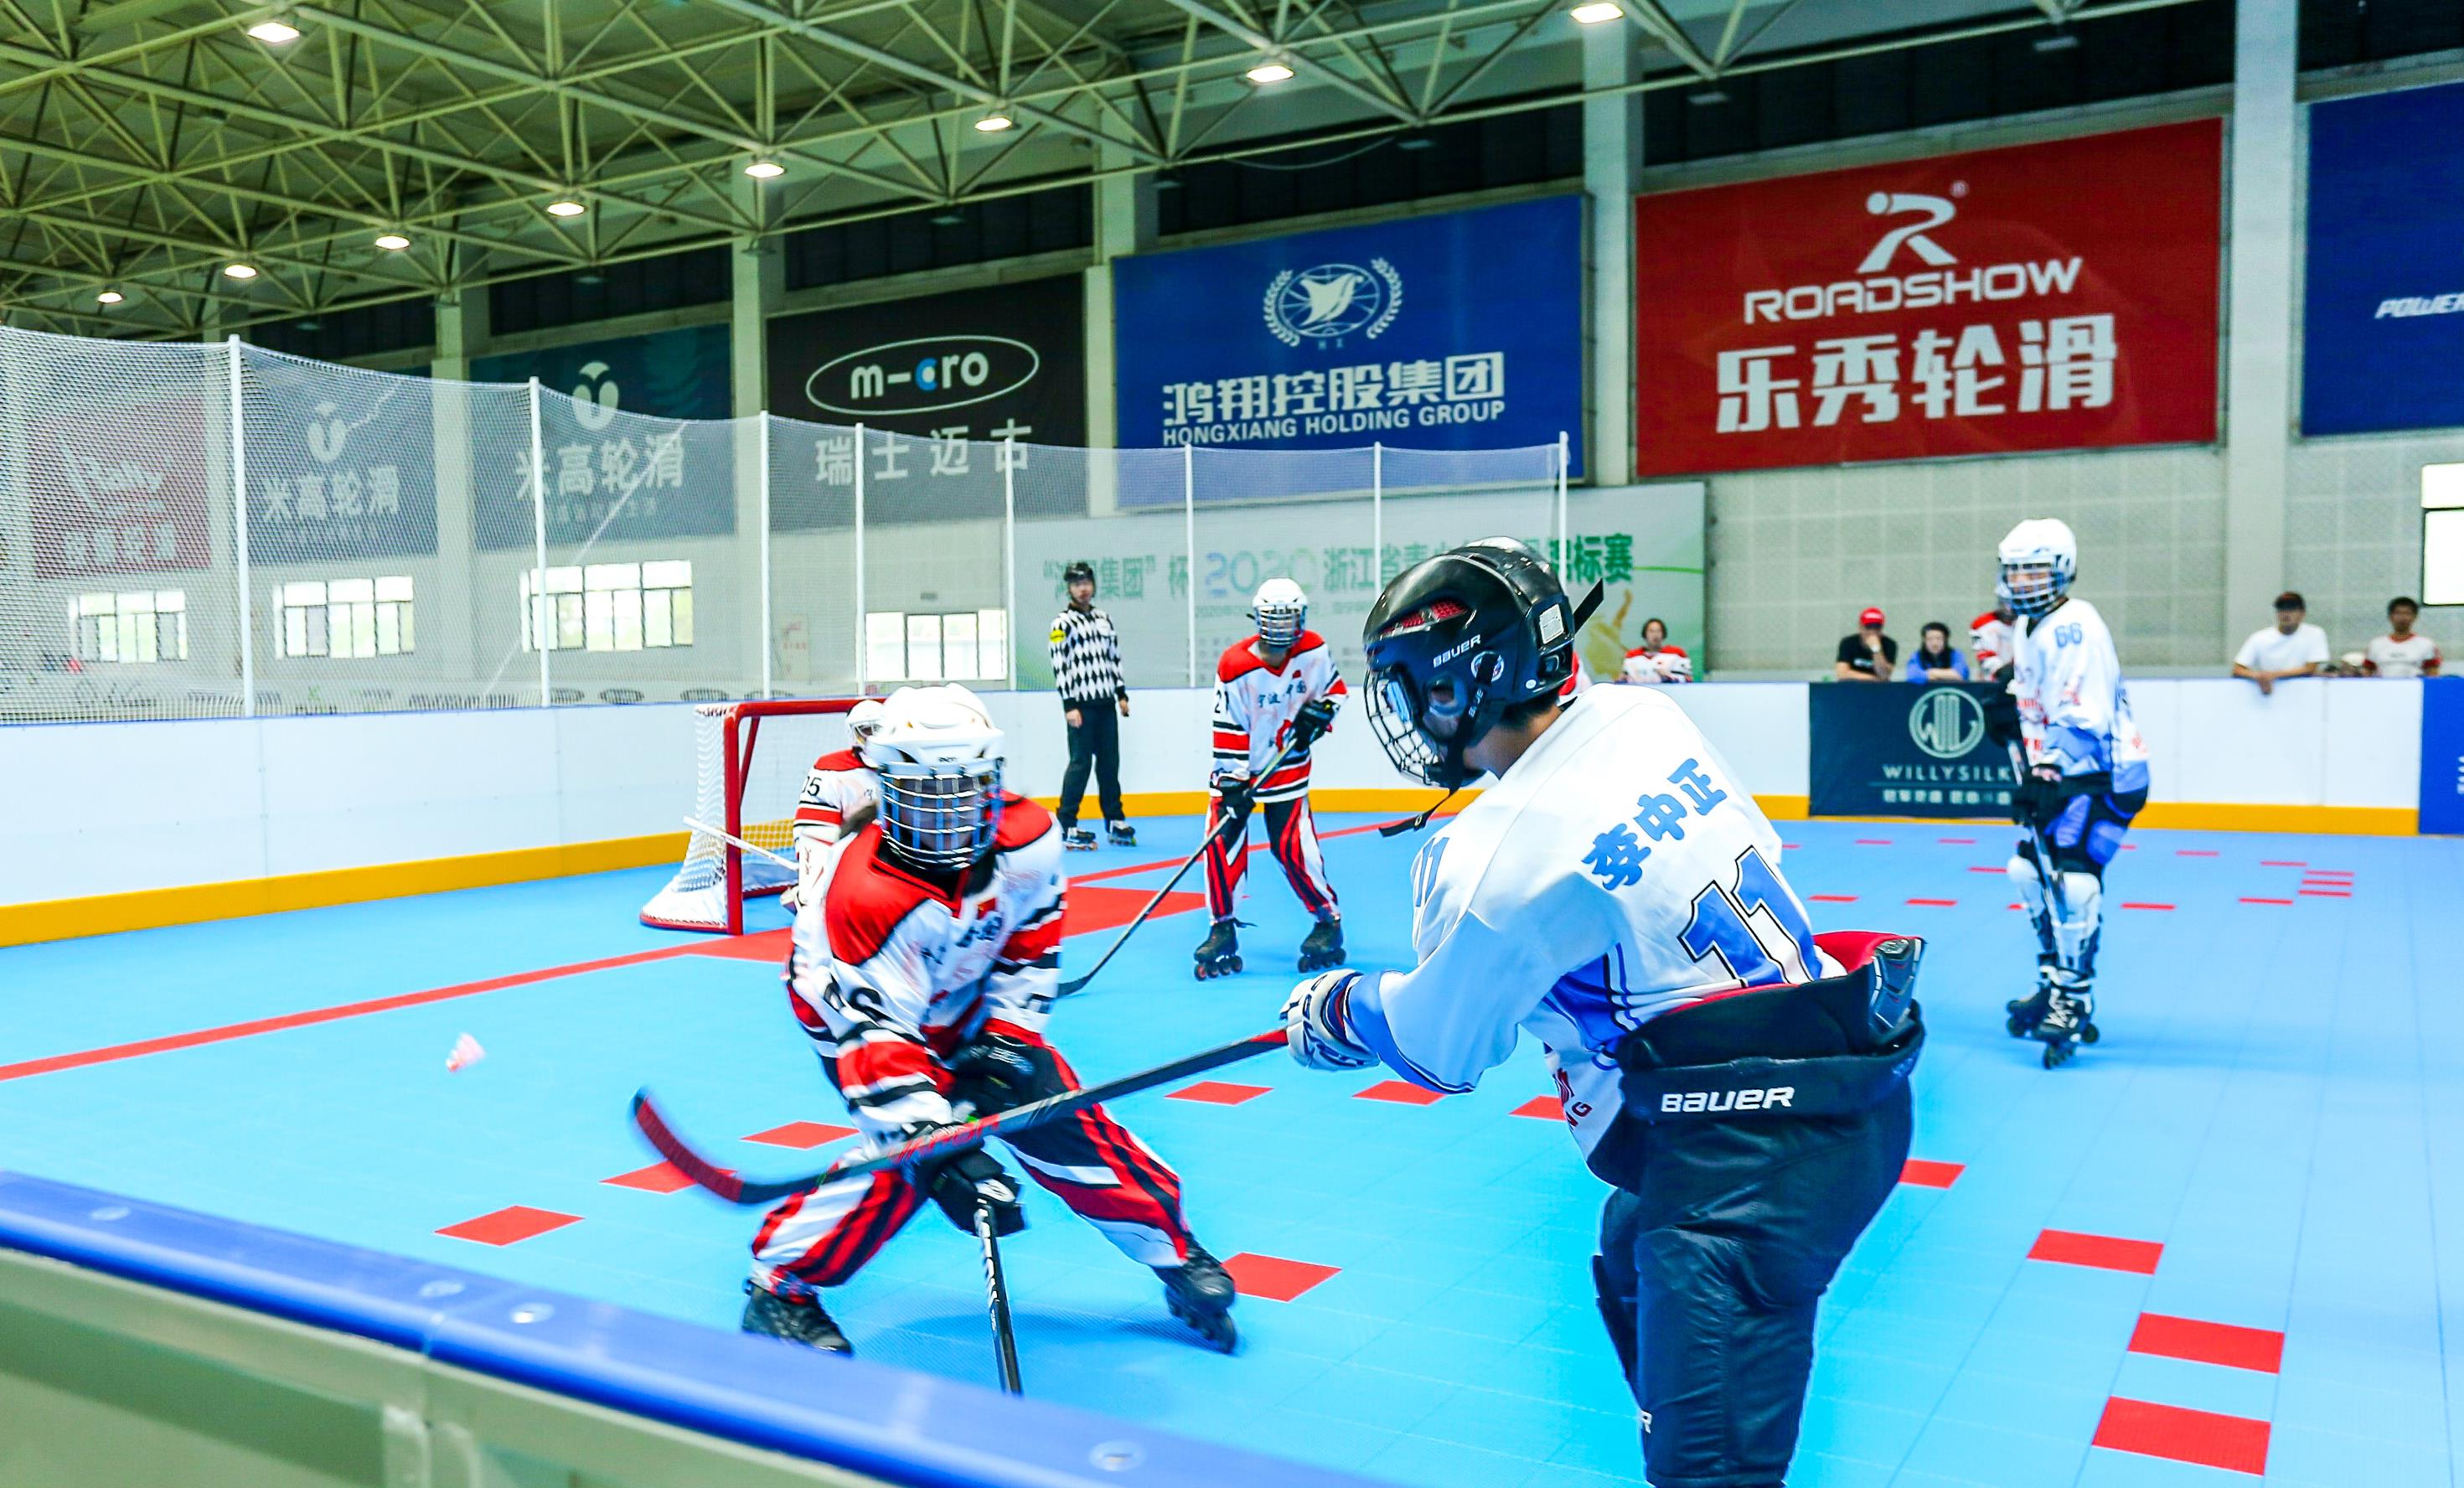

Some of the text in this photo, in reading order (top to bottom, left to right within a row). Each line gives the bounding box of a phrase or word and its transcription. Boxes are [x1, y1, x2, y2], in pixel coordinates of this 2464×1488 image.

[1743, 256, 2084, 325] ROADSHOW
[1162, 351, 1506, 427] 鸿翔控股集团
[1716, 313, 2117, 433] 乐秀轮滑
[815, 418, 1032, 486] 瑞士迈古
[1162, 400, 1506, 447] HONGXIANG HOLDING GROUP
[1433, 633, 1481, 669] BAUER
[2053, 622, 2083, 648] 66
[1882, 763, 2012, 783] WILLYSILK
[1581, 757, 1728, 891] 李中正
[1676, 845, 1823, 989] 11
